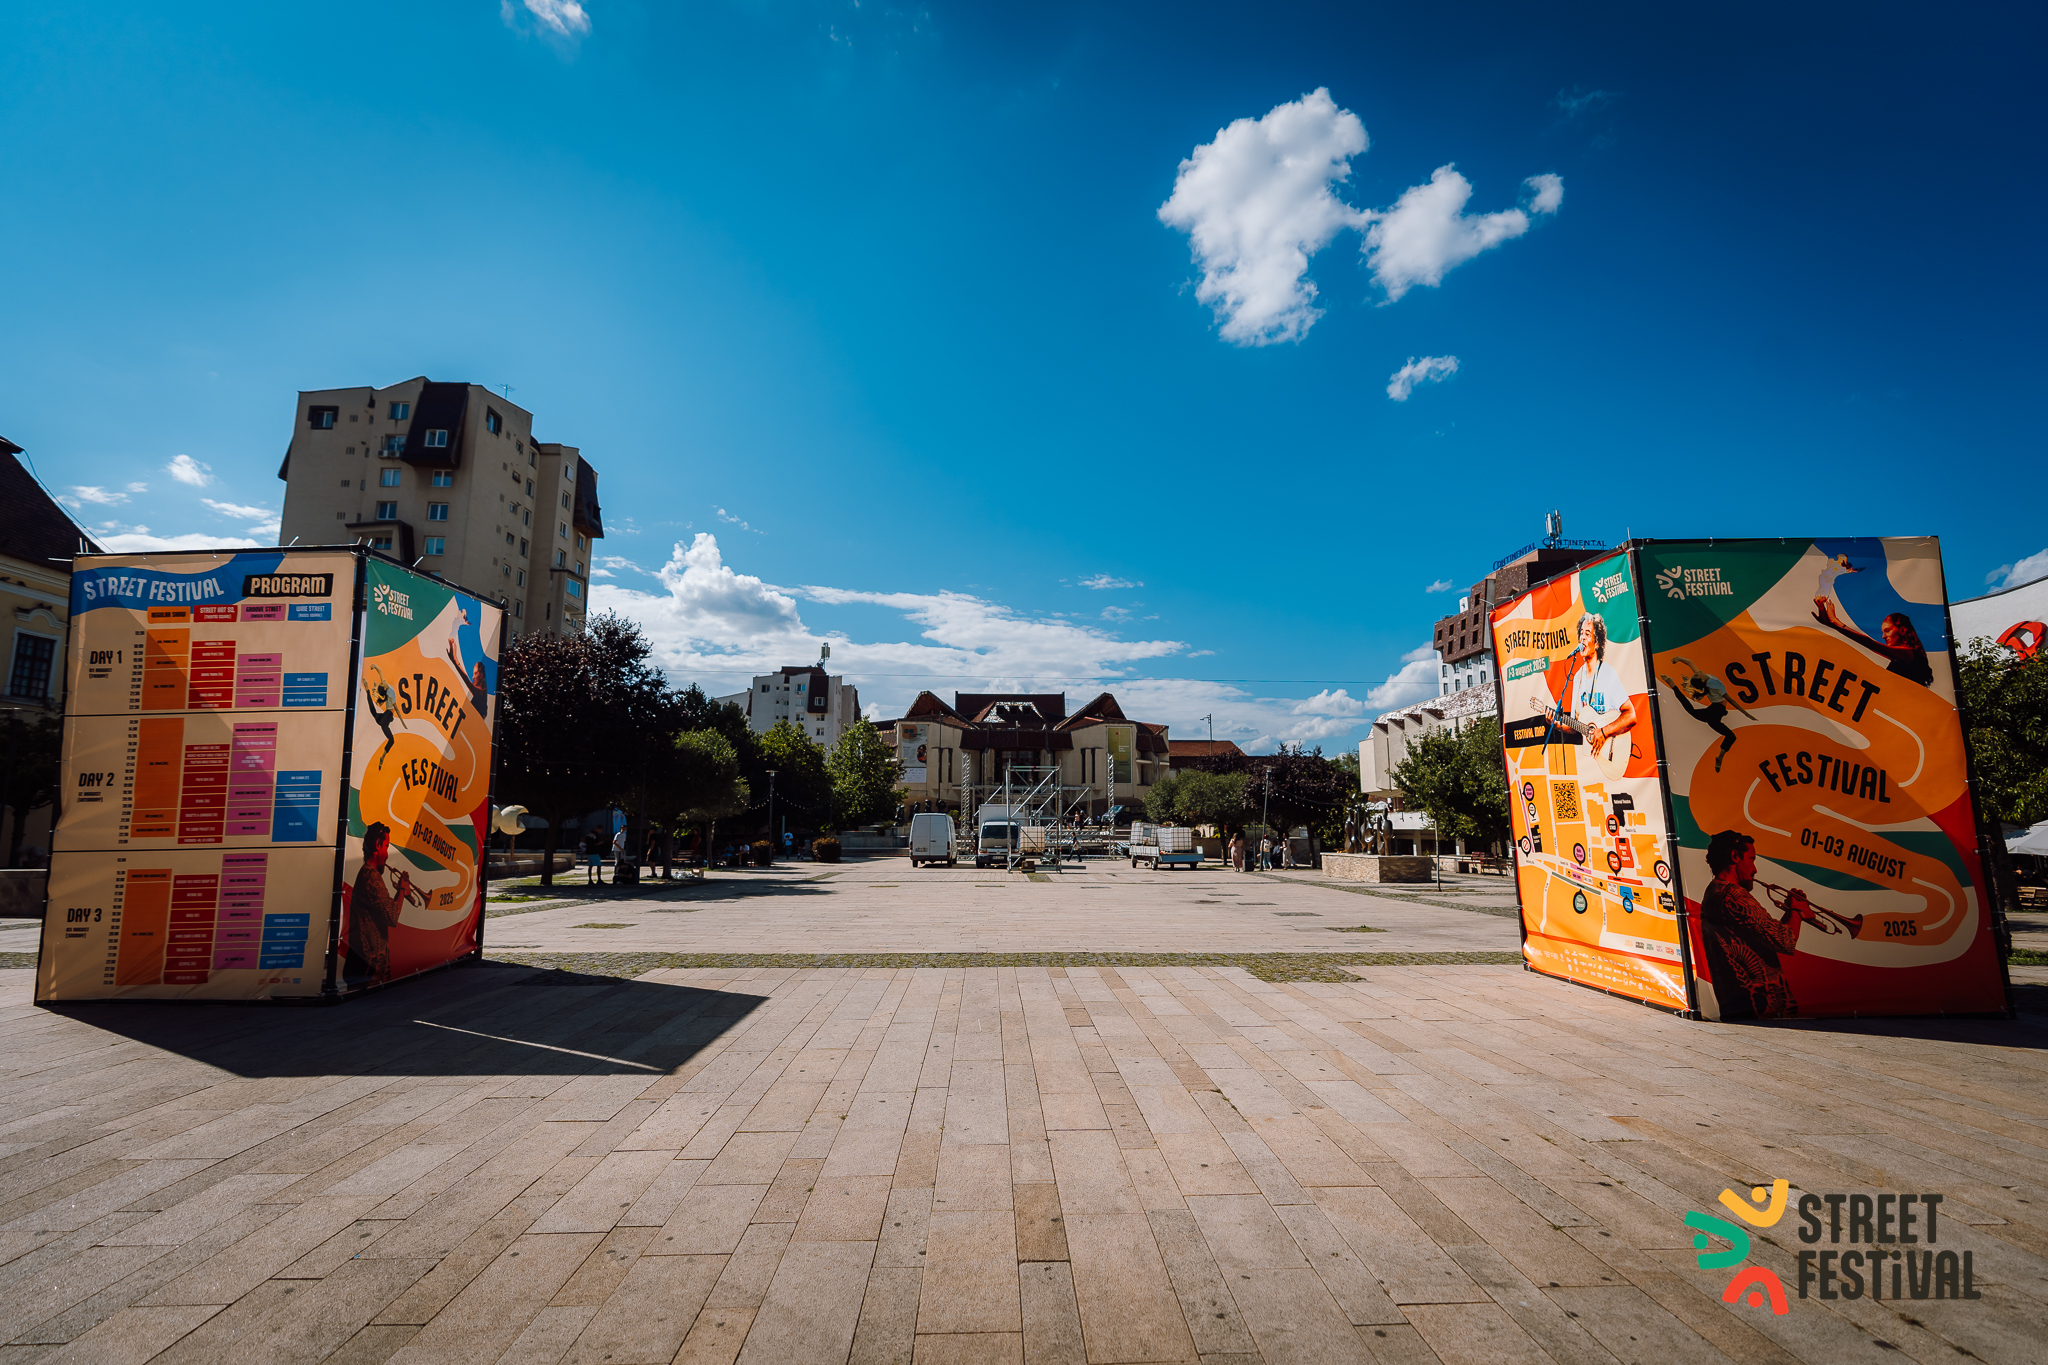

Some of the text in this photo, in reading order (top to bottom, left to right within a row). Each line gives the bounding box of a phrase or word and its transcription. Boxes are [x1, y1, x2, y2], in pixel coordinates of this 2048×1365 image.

[1492, 542, 1536, 571] CONTINENTAL
[1604, 572, 1623, 588] STREET
[1683, 568, 1721, 582] STREET
[83, 576, 326, 602] STREET FESTIVAL PROGRAM
[388, 589, 410, 607] STREET
[1505, 627, 1570, 653] STREET FESTIVAL
[89, 650, 122, 664] DAY 1
[1515, 663, 1533, 677] august
[1533, 658, 1547, 671] 2025
[1725, 651, 1881, 723] STREET
[398, 673, 466, 740] STREET
[1514, 726, 1546, 740] FESTIVAL MAP
[78, 772, 114, 787] DAY 2
[401, 758, 459, 804] FESTIVAL
[1758, 751, 1891, 803] FESTIVAL
[412, 821, 457, 861] 01-03 AUGUST
[1800, 828, 1906, 880] 01-03 AUGUST
[439, 892, 454, 906] 2025
[67, 908, 102, 922] DAY 3
[1883, 920, 1917, 937] 2025
